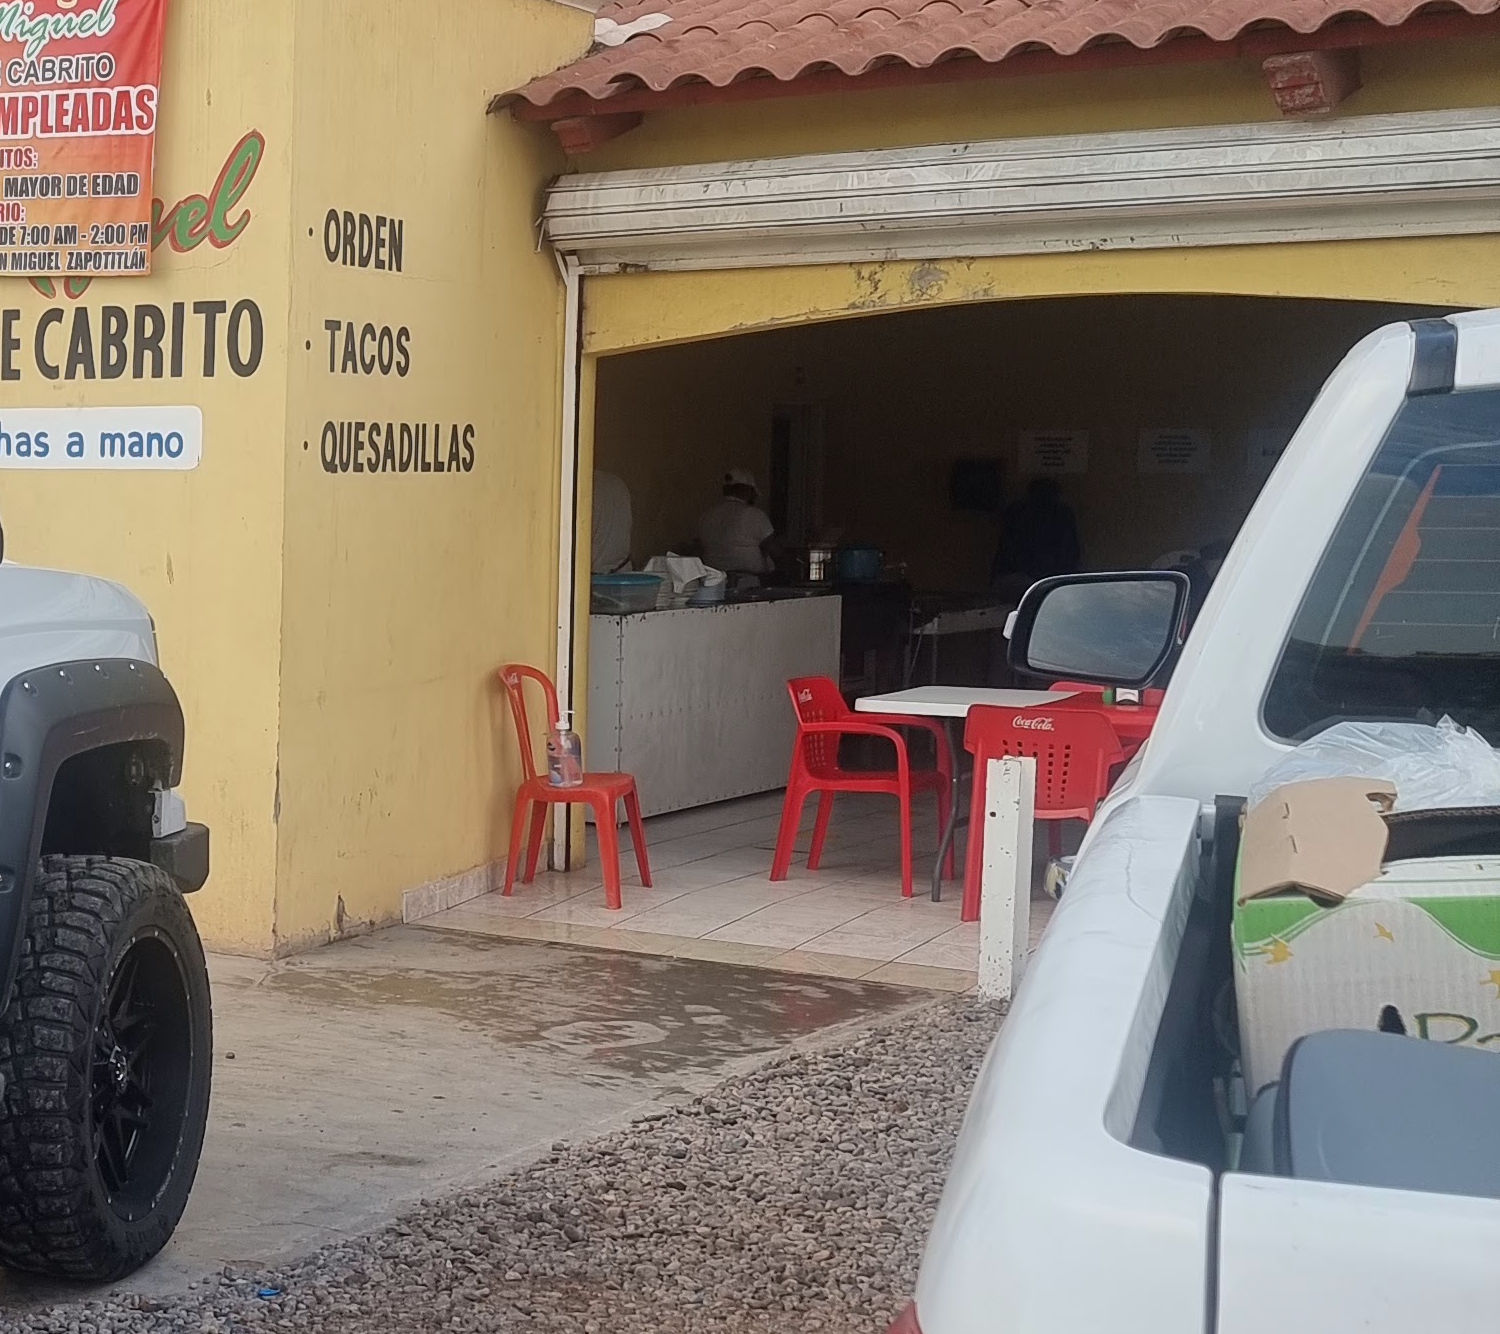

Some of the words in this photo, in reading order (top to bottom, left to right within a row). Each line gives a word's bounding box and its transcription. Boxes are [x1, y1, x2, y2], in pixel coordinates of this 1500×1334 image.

[7, 54, 115, 85] CABRITO
[4, 175, 62, 198] MAYOR
[66, 174, 89, 197] DE
[91, 173, 140, 197] EDAD
[19, 225, 51, 246] 7:00
[53, 224, 78, 246] AM
[90, 223, 127, 246] 2:00
[129, 222, 149, 245] PM
[323, 208, 404, 273] ORDEN
[11, 250, 62, 272] MIGUEL
[66, 247, 147, 271] ZAPOTITLÁN
[34, 298, 265, 381] CABRITO
[323, 319, 412, 378] TACOS
[67, 430, 86, 458] a
[99, 430, 185, 458] mano
[320, 421, 476, 474] QUESADILLAS
